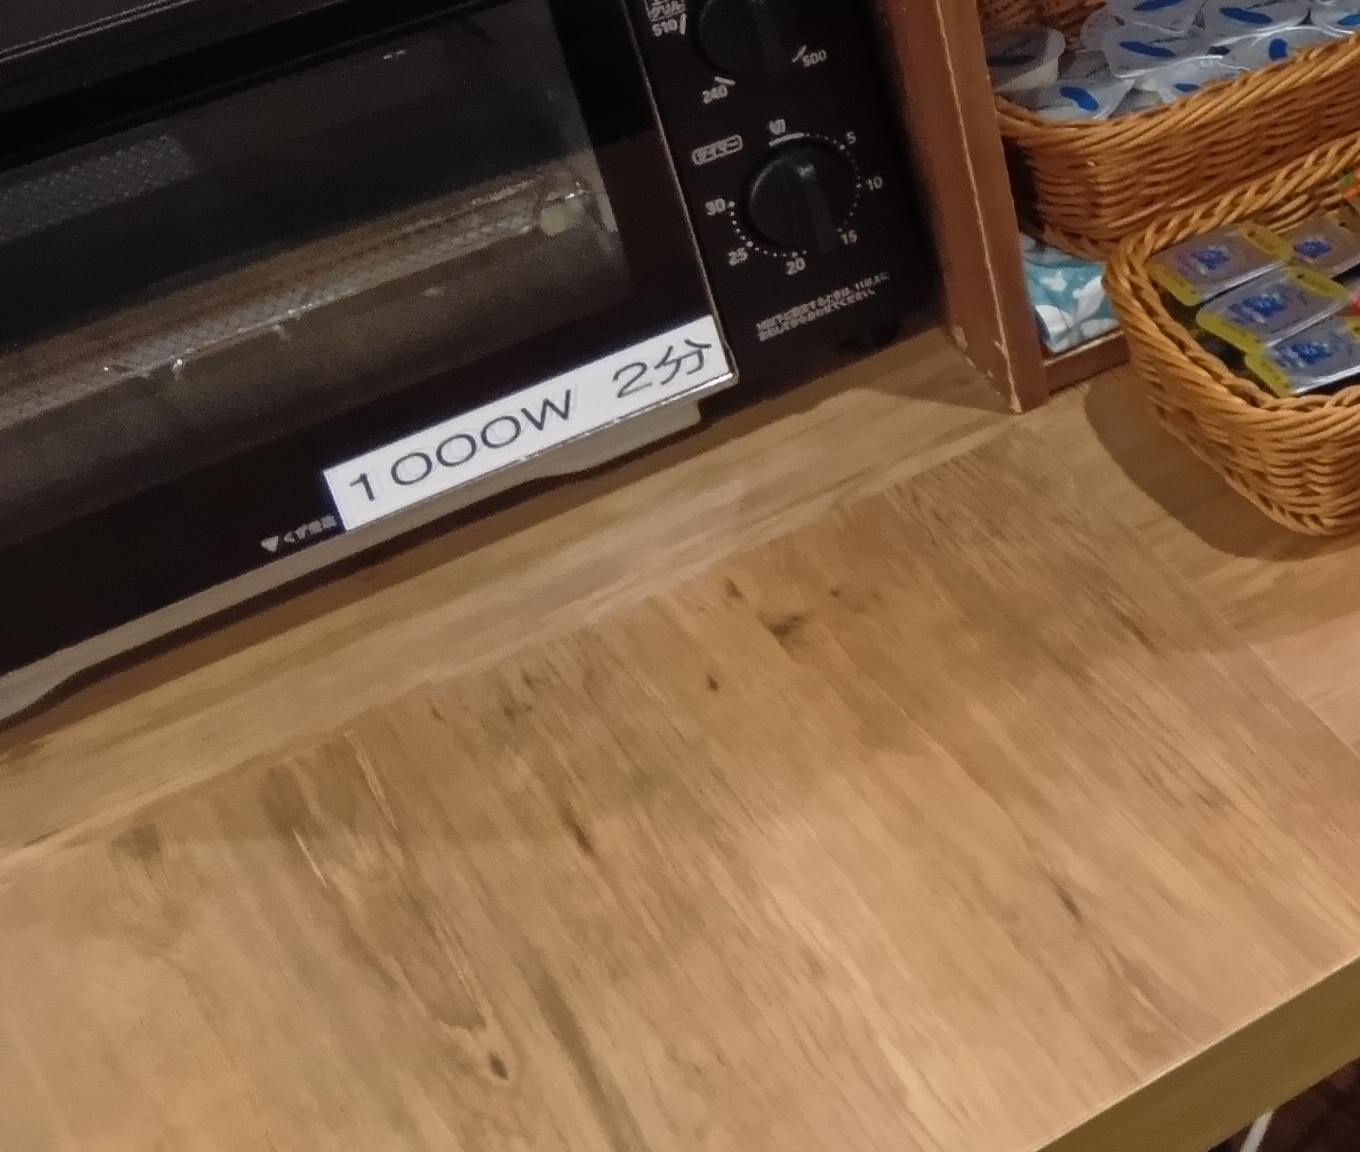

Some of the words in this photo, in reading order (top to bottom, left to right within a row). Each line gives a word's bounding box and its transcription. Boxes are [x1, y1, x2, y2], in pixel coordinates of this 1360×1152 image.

[802, 49, 827, 68] 500
[845, 131, 857, 145] 5
[865, 176, 884, 191] 10
[704, 198, 726, 216] 30
[840, 229, 858, 245] 15
[728, 247, 748, 266] 25
[785, 257, 807, 276] 20
[349, 389, 572, 502] 1000W
[612, 337, 713, 399] 2分
